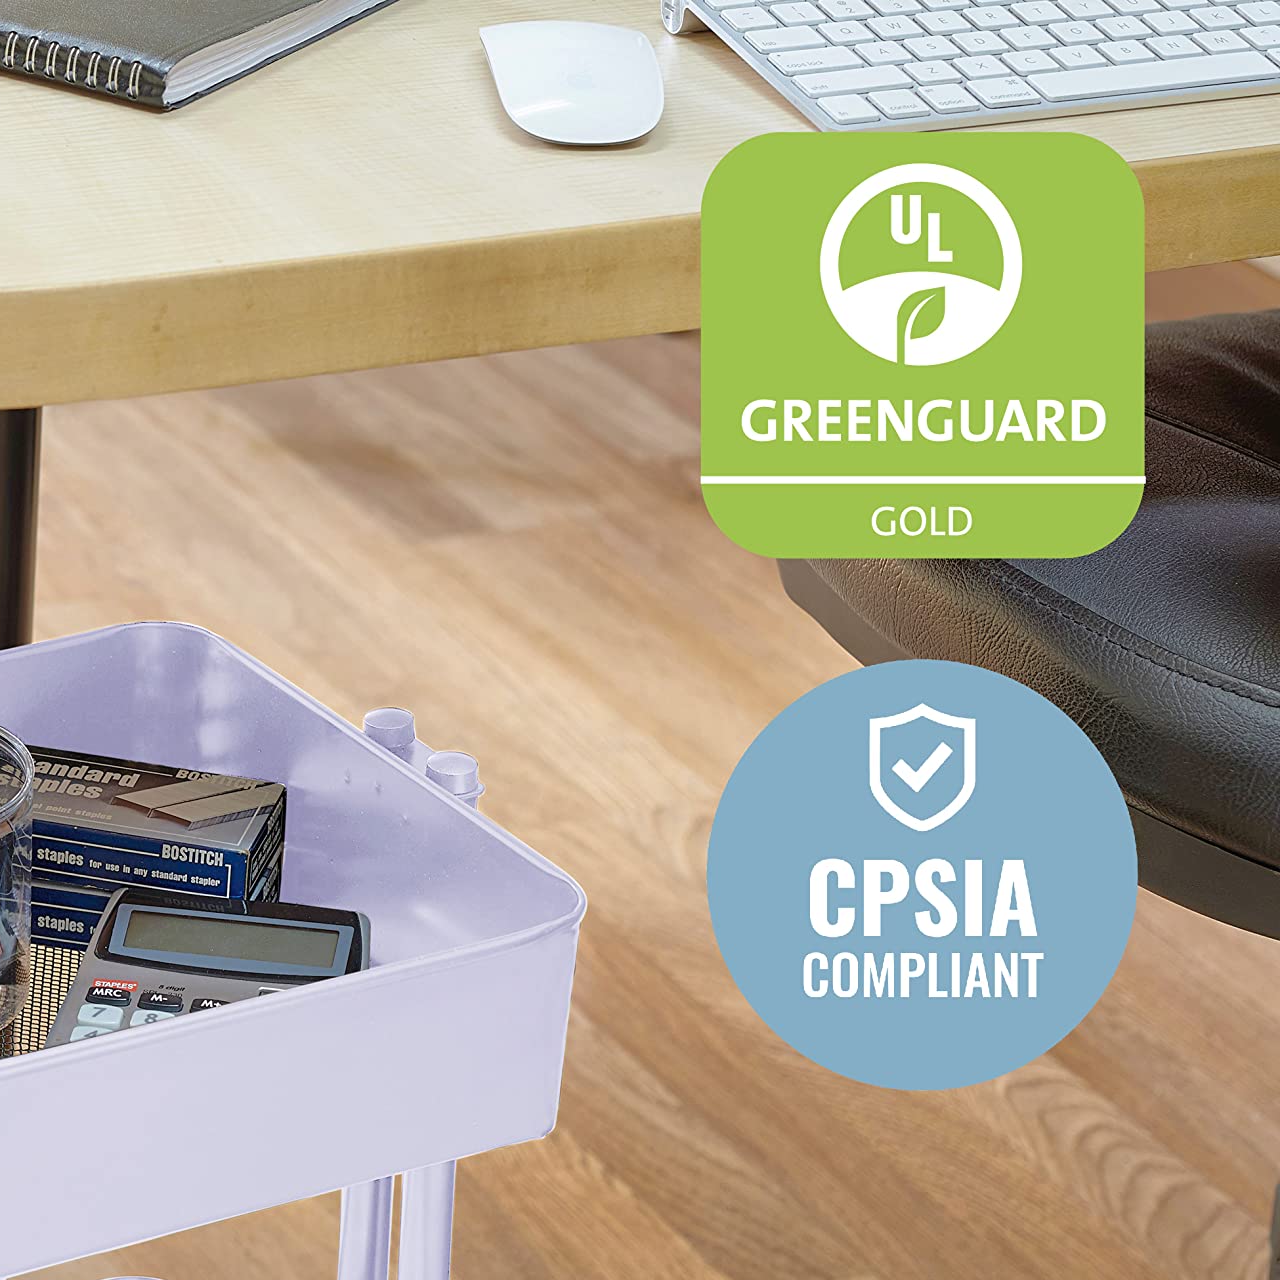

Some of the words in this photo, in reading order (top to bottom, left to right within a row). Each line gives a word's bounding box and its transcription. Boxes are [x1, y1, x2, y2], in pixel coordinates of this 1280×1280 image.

[1080, 2, 1089, 10] Y
[985, 11, 997, 20] R
[1033, 7, 1044, 15] T
[938, 16, 948, 25] E
[1211, 12, 1224, 20] K
[887, 21, 904, 31] W
[1117, 21, 1131, 30] H
[839, 27, 854, 36] Q
[1023, 31, 1033, 40] F
[1070, 26, 1083, 36] G
[973, 37, 986, 46] D
[1167, 40, 1181, 50] N
[878, 46, 890, 56] A
[926, 42, 937, 51] S
[1121, 46, 1132, 55] B
[1072, 50, 1083, 59] V
[1024, 56, 1036, 65] C
[975, 61, 988, 70] X
[926, 66, 938, 75] Z
[161, 844, 225, 867] BOSTITCH
[37, 847, 84, 866] staples
[89, 859, 103, 869] for
[105, 862, 120, 872] use
[122, 864, 131, 874] in
[133, 866, 148, 878] any
[151, 869, 188, 883] standard
[190, 874, 221, 888] stapler
[37, 915, 84, 933] staples
[92, 988, 123, 998] MRC
[150, 994, 168, 1002] M-
[93, 1007, 107, 1018] 7
[144, 1013, 158, 1024] 8
